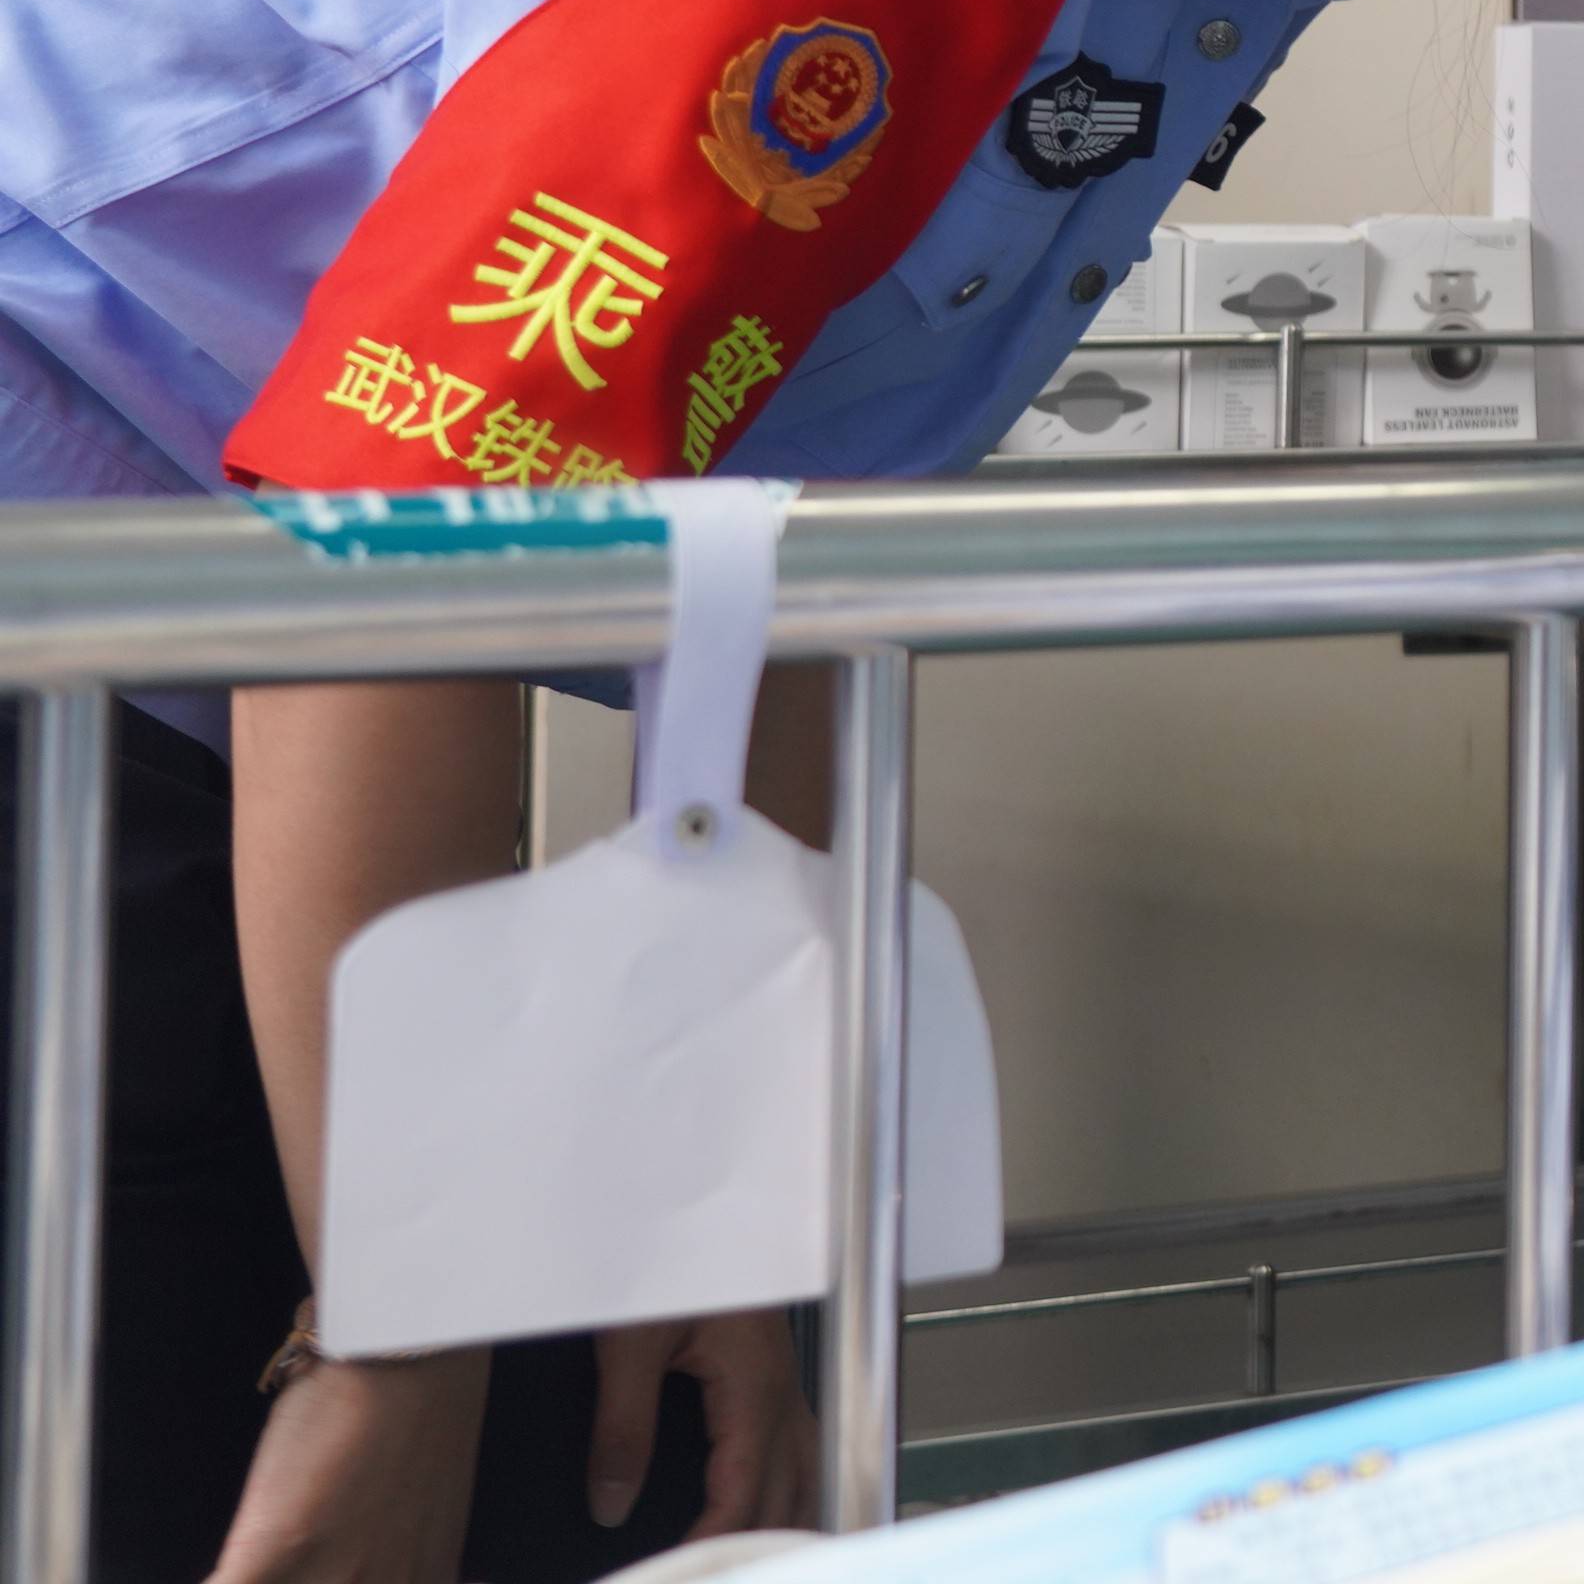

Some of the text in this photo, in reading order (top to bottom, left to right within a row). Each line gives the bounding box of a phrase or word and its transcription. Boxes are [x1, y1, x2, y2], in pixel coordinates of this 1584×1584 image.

[1053, 114, 1087, 130] POLICE
[448, 191, 670, 391] 乘
[1415, 407, 1438, 418] FAN
[1384, 417, 1519, 433] ASTRONAUT LEAFLESS
